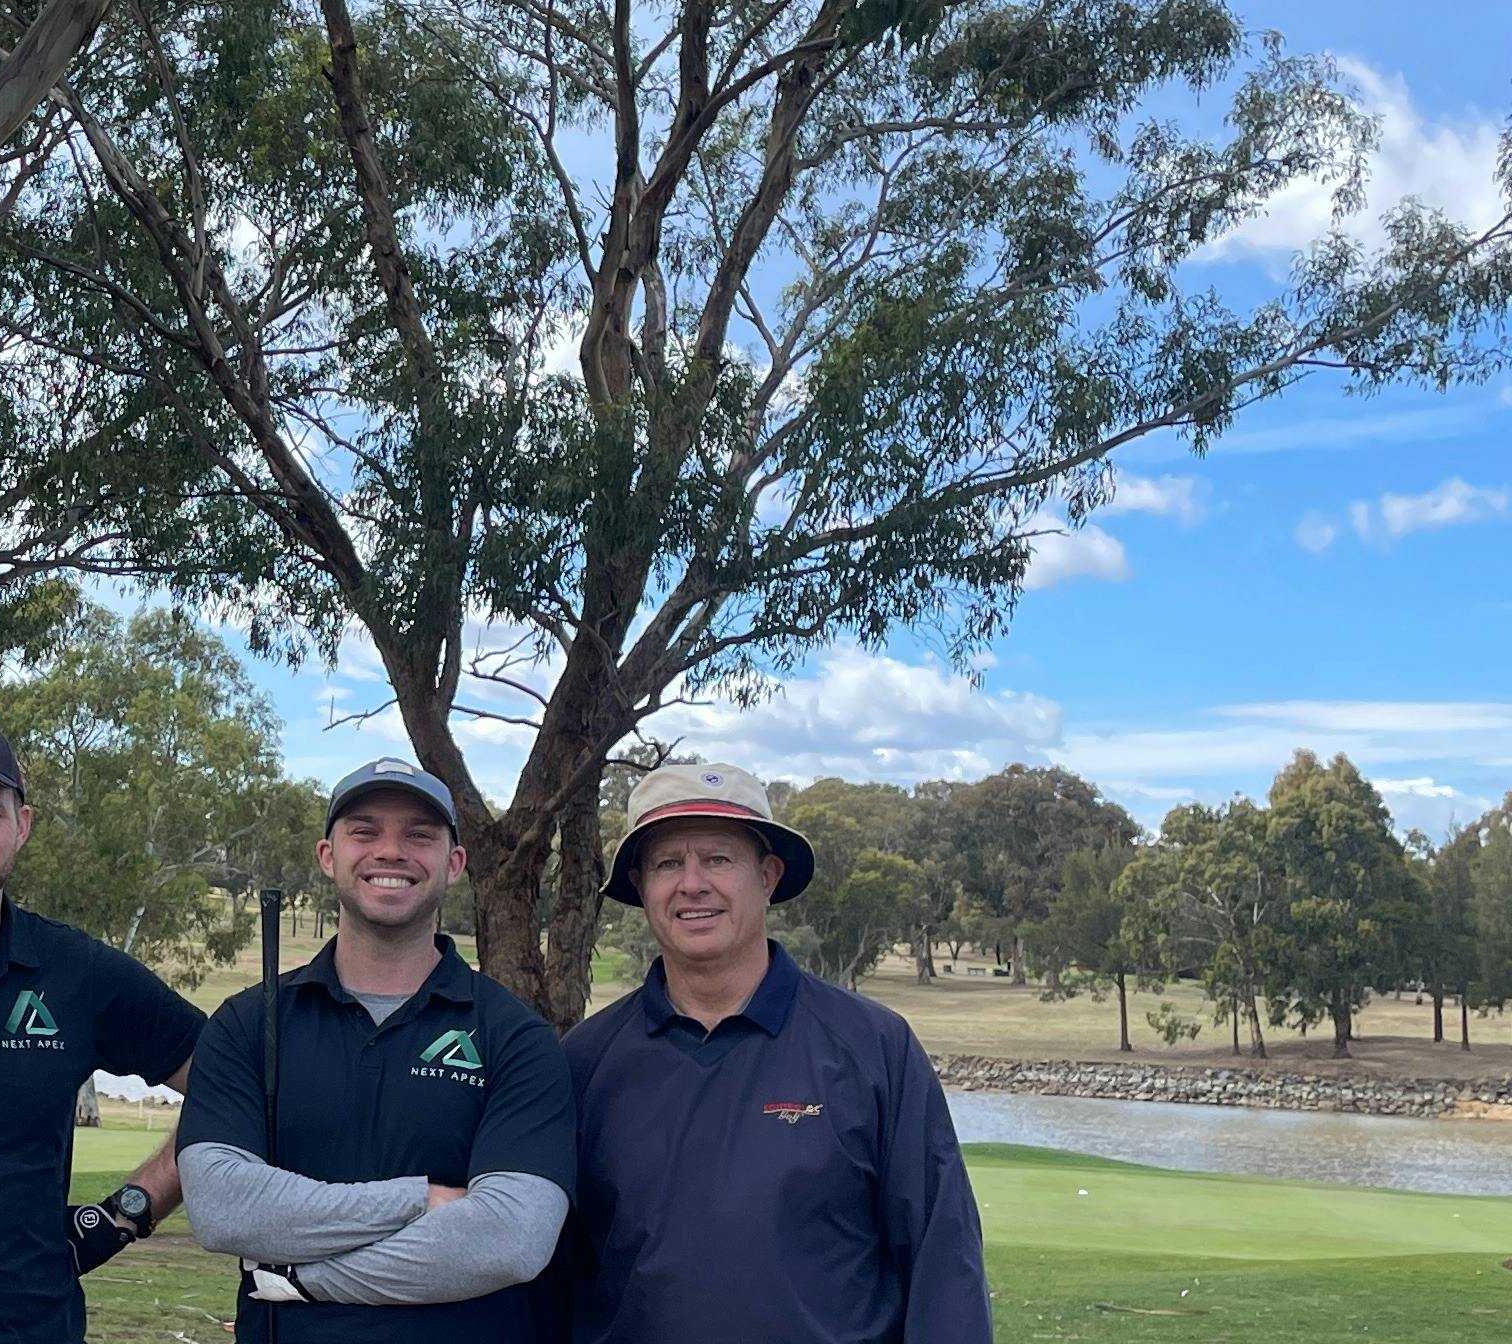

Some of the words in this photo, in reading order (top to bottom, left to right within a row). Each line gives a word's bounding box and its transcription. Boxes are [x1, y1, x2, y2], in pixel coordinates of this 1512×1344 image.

[1, 1039, 31, 1049] NEXT
[37, 1039, 65, 1051] APEX
[410, 1067, 445, 1078] NEXT
[450, 1071, 485, 1087] APEX
